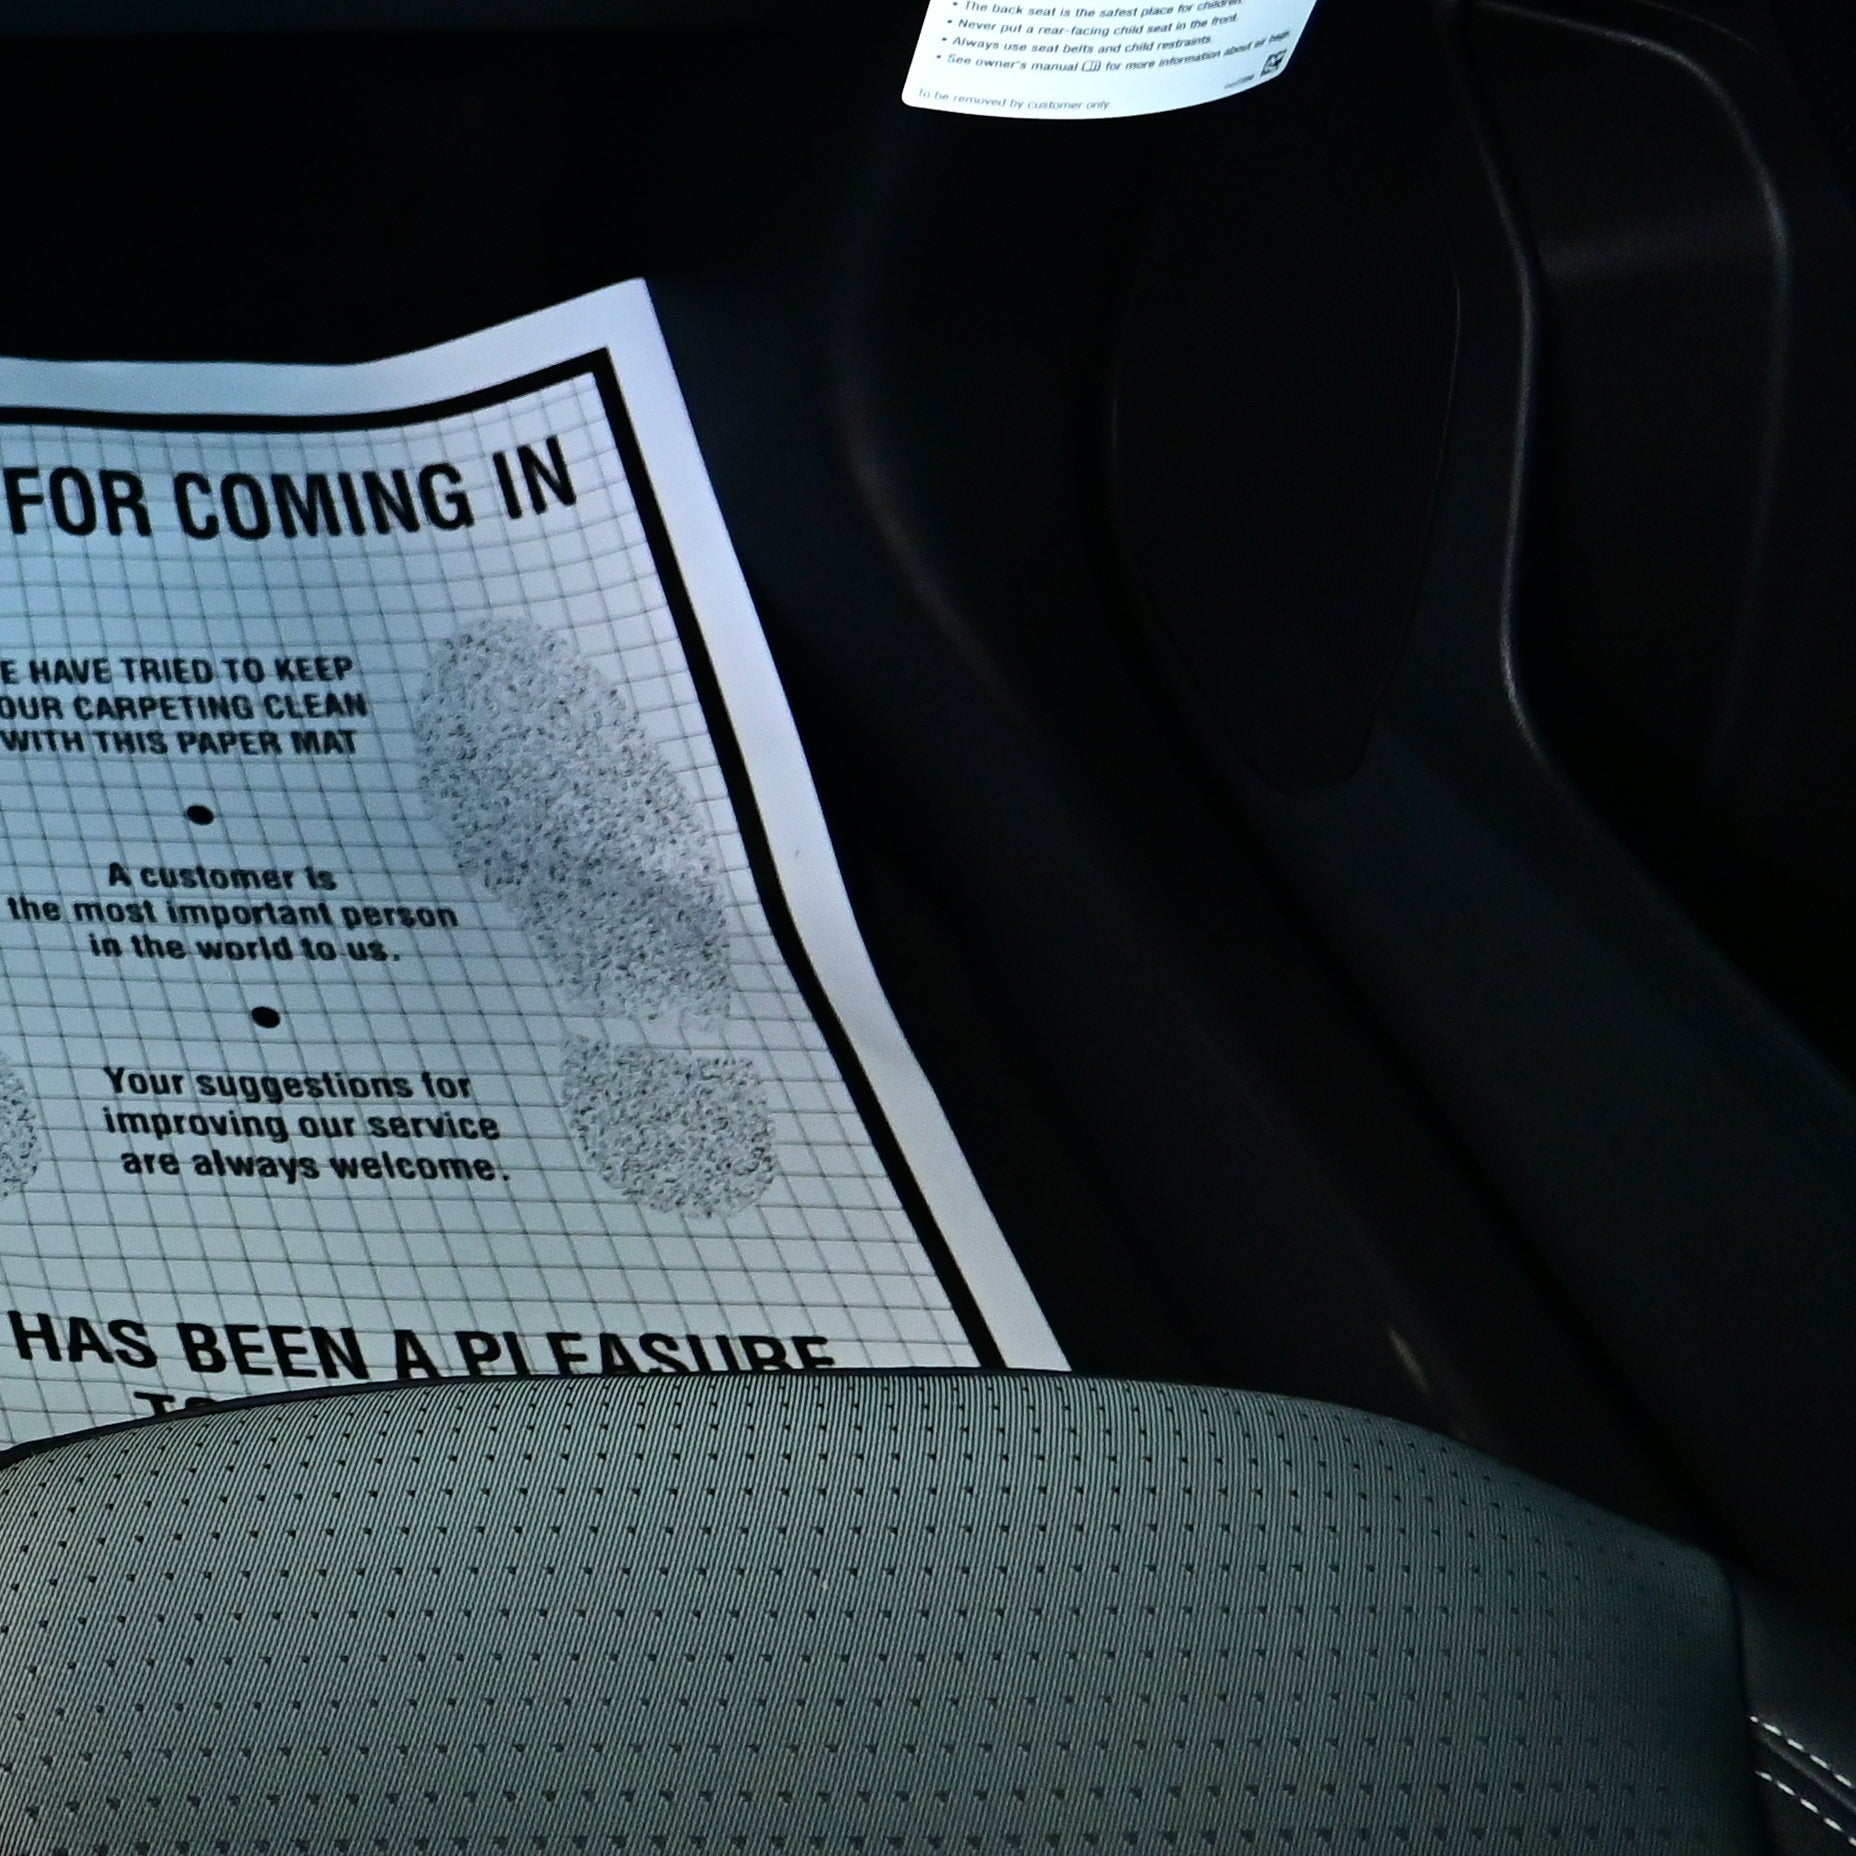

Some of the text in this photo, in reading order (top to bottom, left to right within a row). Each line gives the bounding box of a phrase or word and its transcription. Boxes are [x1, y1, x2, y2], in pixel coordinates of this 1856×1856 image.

[964, 0, 988, 15] The
[991, 1, 1023, 17] back
[1026, 3, 1056, 18] seat
[1059, 5, 1071, 18] is
[1074, 4, 1096, 18] the
[1098, 2, 1136, 19] safest
[1140, 1, 1174, 19] place
[1177, 1, 1194, 13] for
[6, 467, 153, 536] FOR
[174, 461, 473, 539] COMING
[494, 435, 578, 521] IN
[30, 656, 111, 683] HAVE
[122, 656, 212, 683] TRIED
[221, 656, 265, 682] TO
[275, 655, 352, 681] KEEP
[72, 691, 253, 721] CARPETING
[264, 690, 368, 719] CLEAN
[88, 727, 168, 755] THIS
[177, 727, 279, 754] PAPER
[291, 727, 356, 754] MAT
[107, 862, 337, 892] A customer is
[7, 896, 458, 931] the most important person
[88, 933, 400, 963] in the world to us.
[102, 1067, 471, 1105] Your suggestions for
[102, 1106, 499, 1143] improving our service
[121, 1149, 510, 1184] are always welcome.
[8, 1309, 157, 1368] HAS
[174, 1323, 370, 1380] BEEN
[395, 1330, 441, 1378] A
